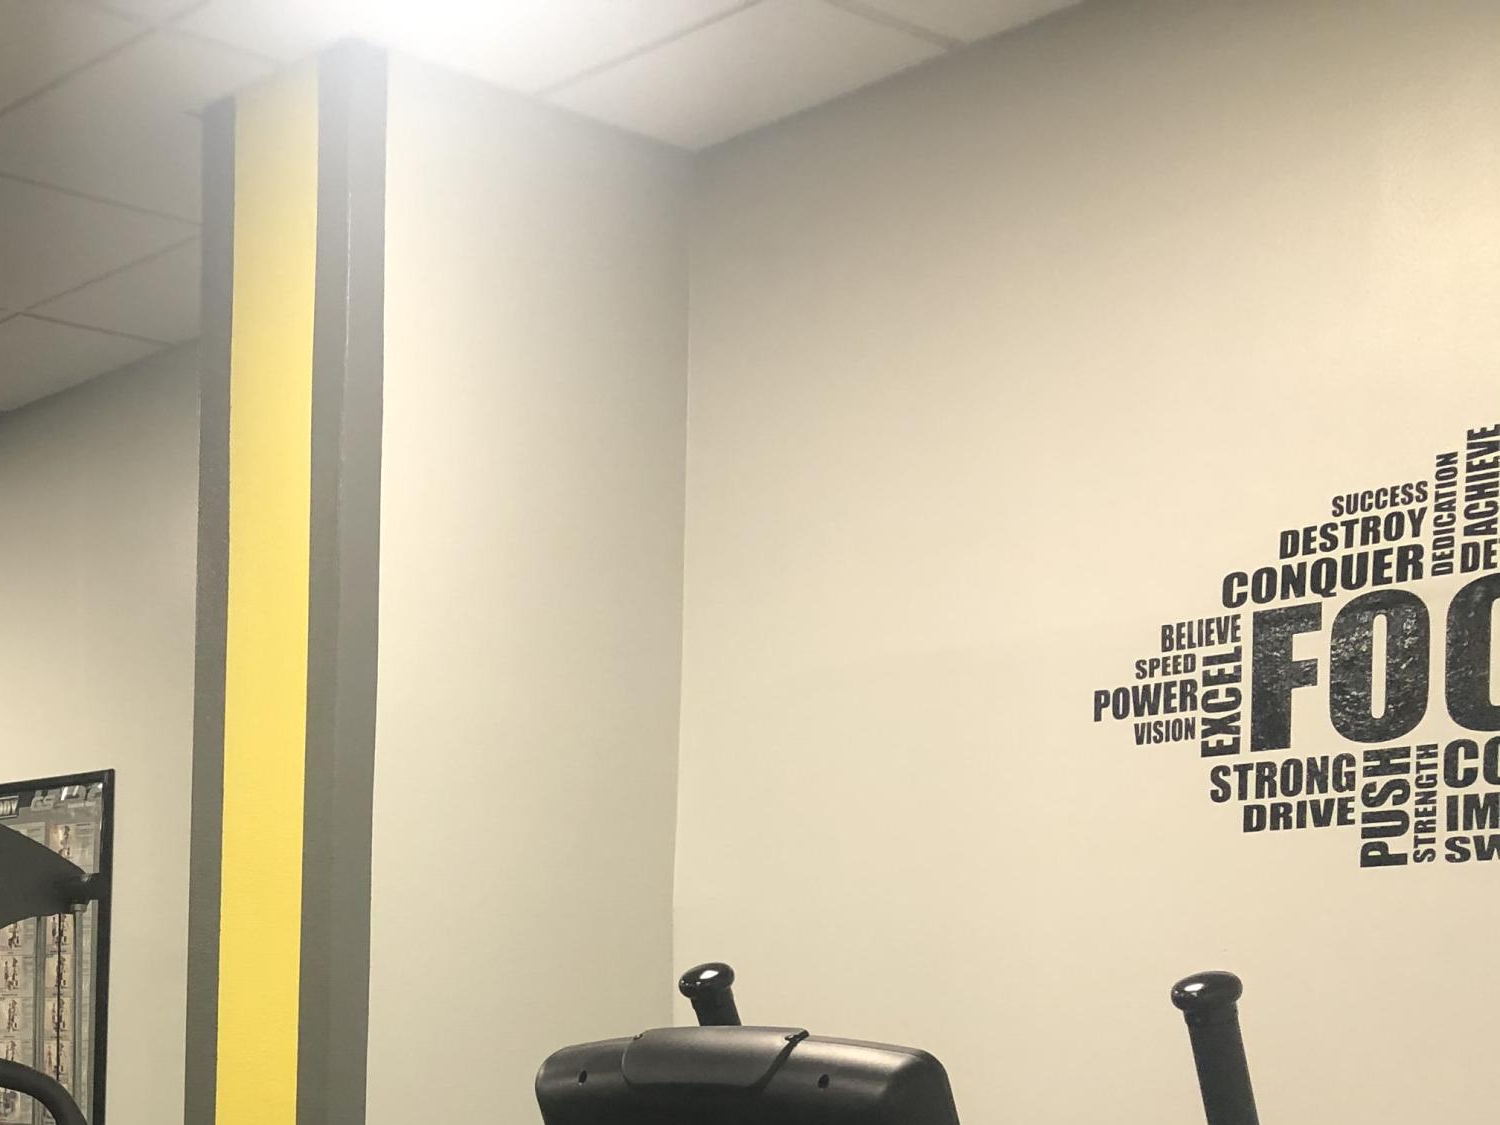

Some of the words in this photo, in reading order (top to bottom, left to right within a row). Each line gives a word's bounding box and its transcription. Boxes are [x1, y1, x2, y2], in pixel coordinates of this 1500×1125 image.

[1331, 480, 1428, 518] SUCCESS
[1463, 424, 1500, 537] ACHIEVE
[1279, 506, 1428, 559] DESTROY
[1431, 451, 1458, 576] DEDICATION
[1222, 543, 1425, 608] CONQUER
[1460, 538, 1500, 573] DE
[1161, 613, 1242, 653] BELIEVE
[1134, 653, 1197, 680] SPEED
[1093, 678, 1198, 722] POWER
[1200, 645, 1242, 758] EXCEL
[1133, 716, 1197, 745] VISION
[1210, 752, 1356, 804] STRONG
[1413, 743, 1439, 863] STRENGTH
[1243, 795, 1356, 833] DRIVE
[1360, 745, 1412, 868] PUSH
